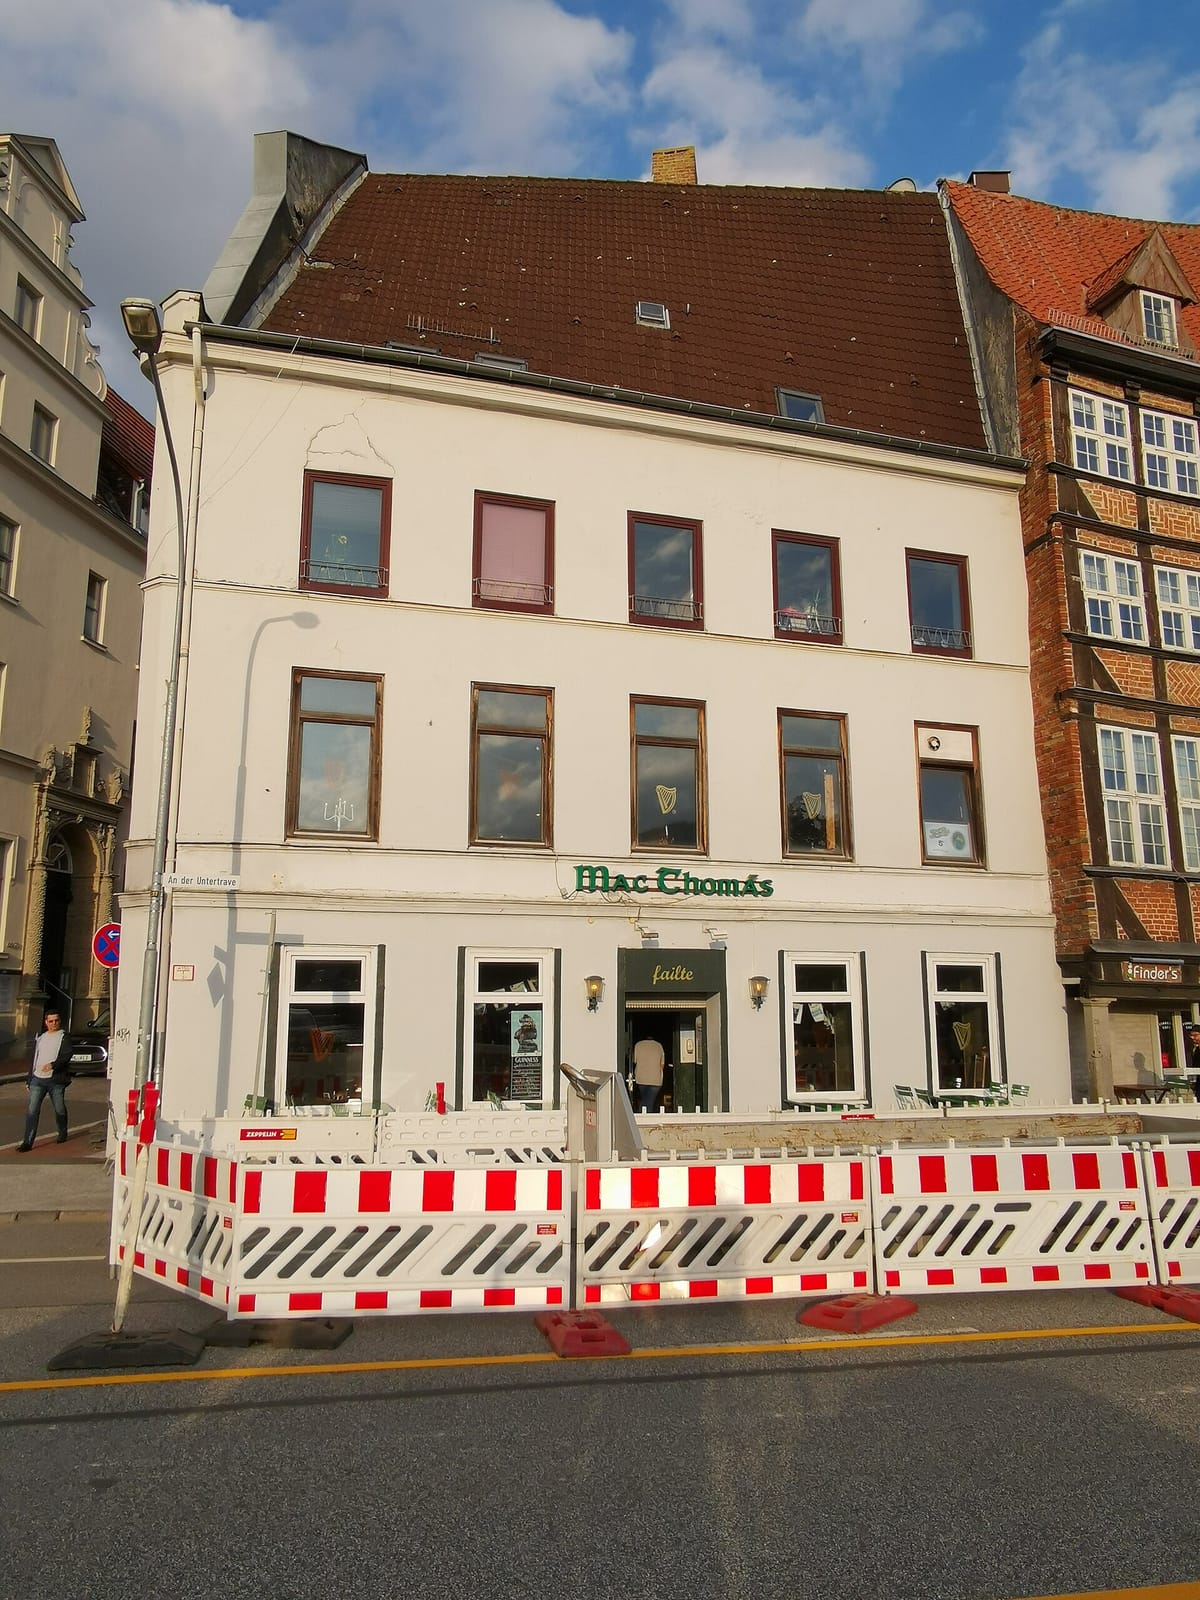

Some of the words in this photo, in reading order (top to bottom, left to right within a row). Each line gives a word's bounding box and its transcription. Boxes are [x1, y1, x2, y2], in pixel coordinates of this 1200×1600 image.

[168, 875, 178, 884] An
[180, 876, 194, 885] der
[196, 876, 237, 886] Untertrave
[573, 864, 649, 893] Mac
[652, 964, 695, 985] failte
[1133, 965, 1178, 980] Finder's
